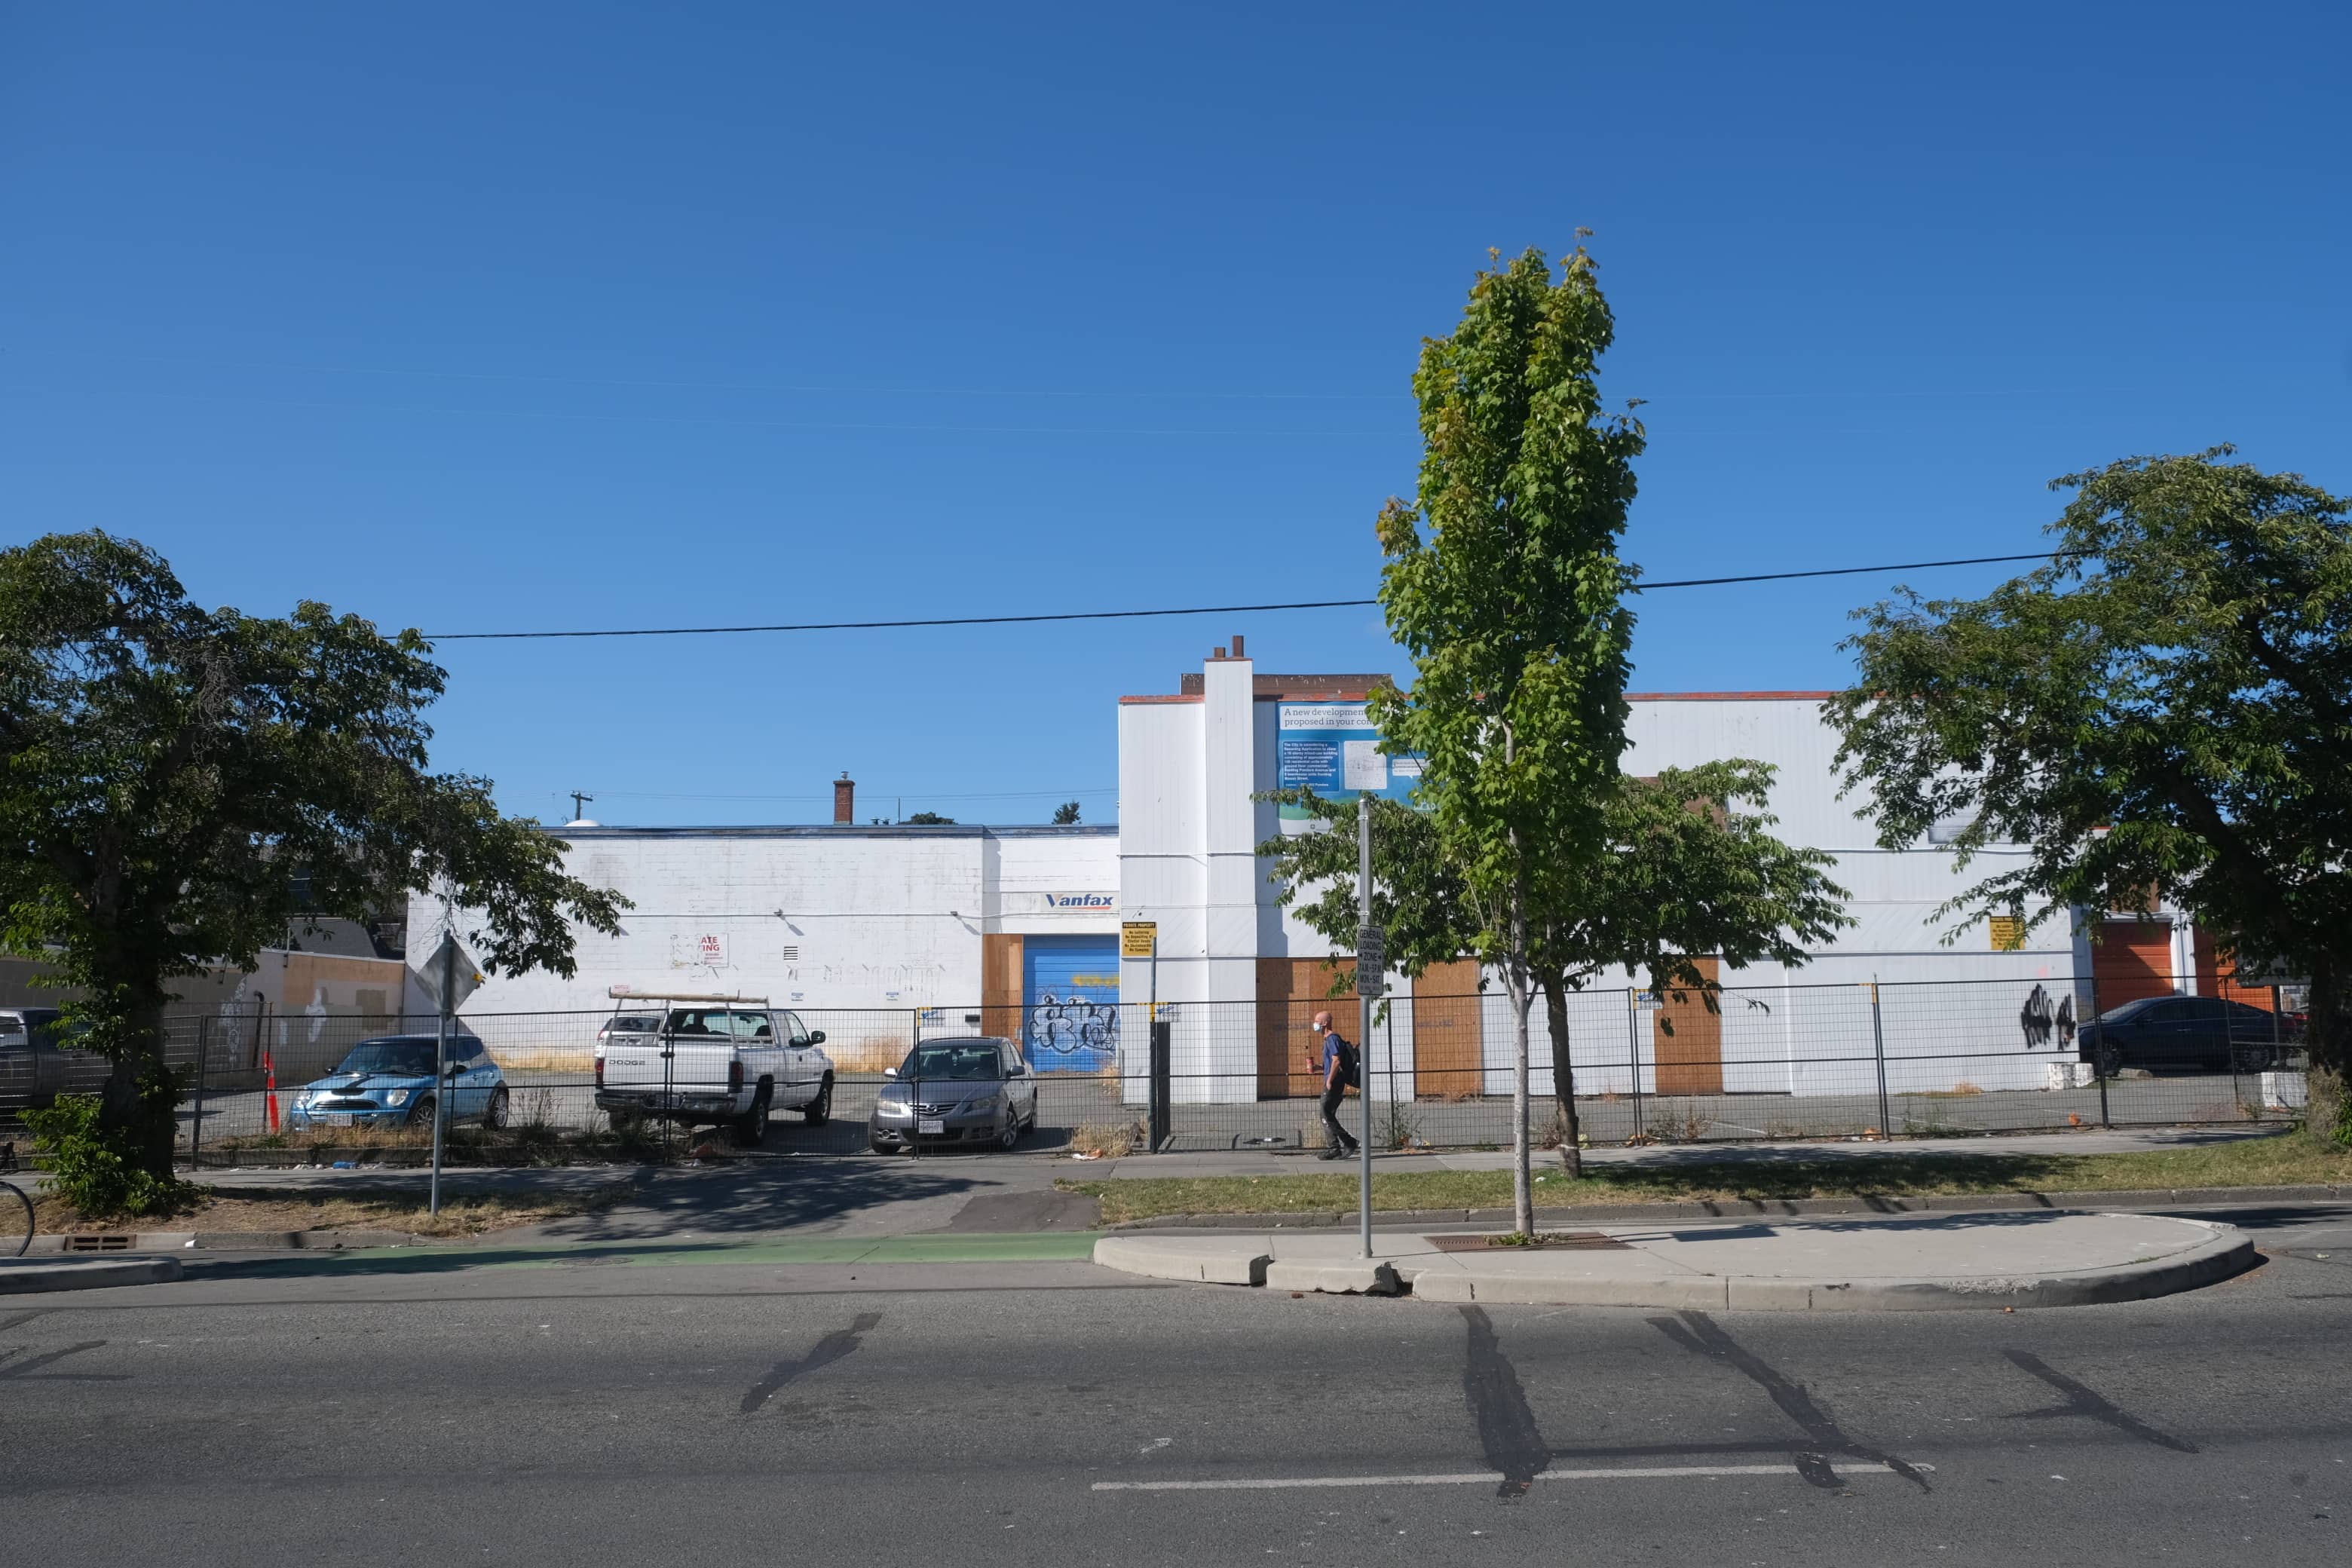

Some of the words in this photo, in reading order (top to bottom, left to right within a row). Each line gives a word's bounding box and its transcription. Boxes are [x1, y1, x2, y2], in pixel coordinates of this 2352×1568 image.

[1284, 708, 1291, 716] A
[1312, 708, 1365, 718] developmen
[1285, 718, 1324, 727] proposed
[1336, 718, 1355, 727] your
[1046, 893, 1114, 908] Vanfax
[1359, 929, 1382, 940] GENERAL
[1360, 940, 1382, 951] LOADING
[1364, 952, 1378, 961] ZONE
